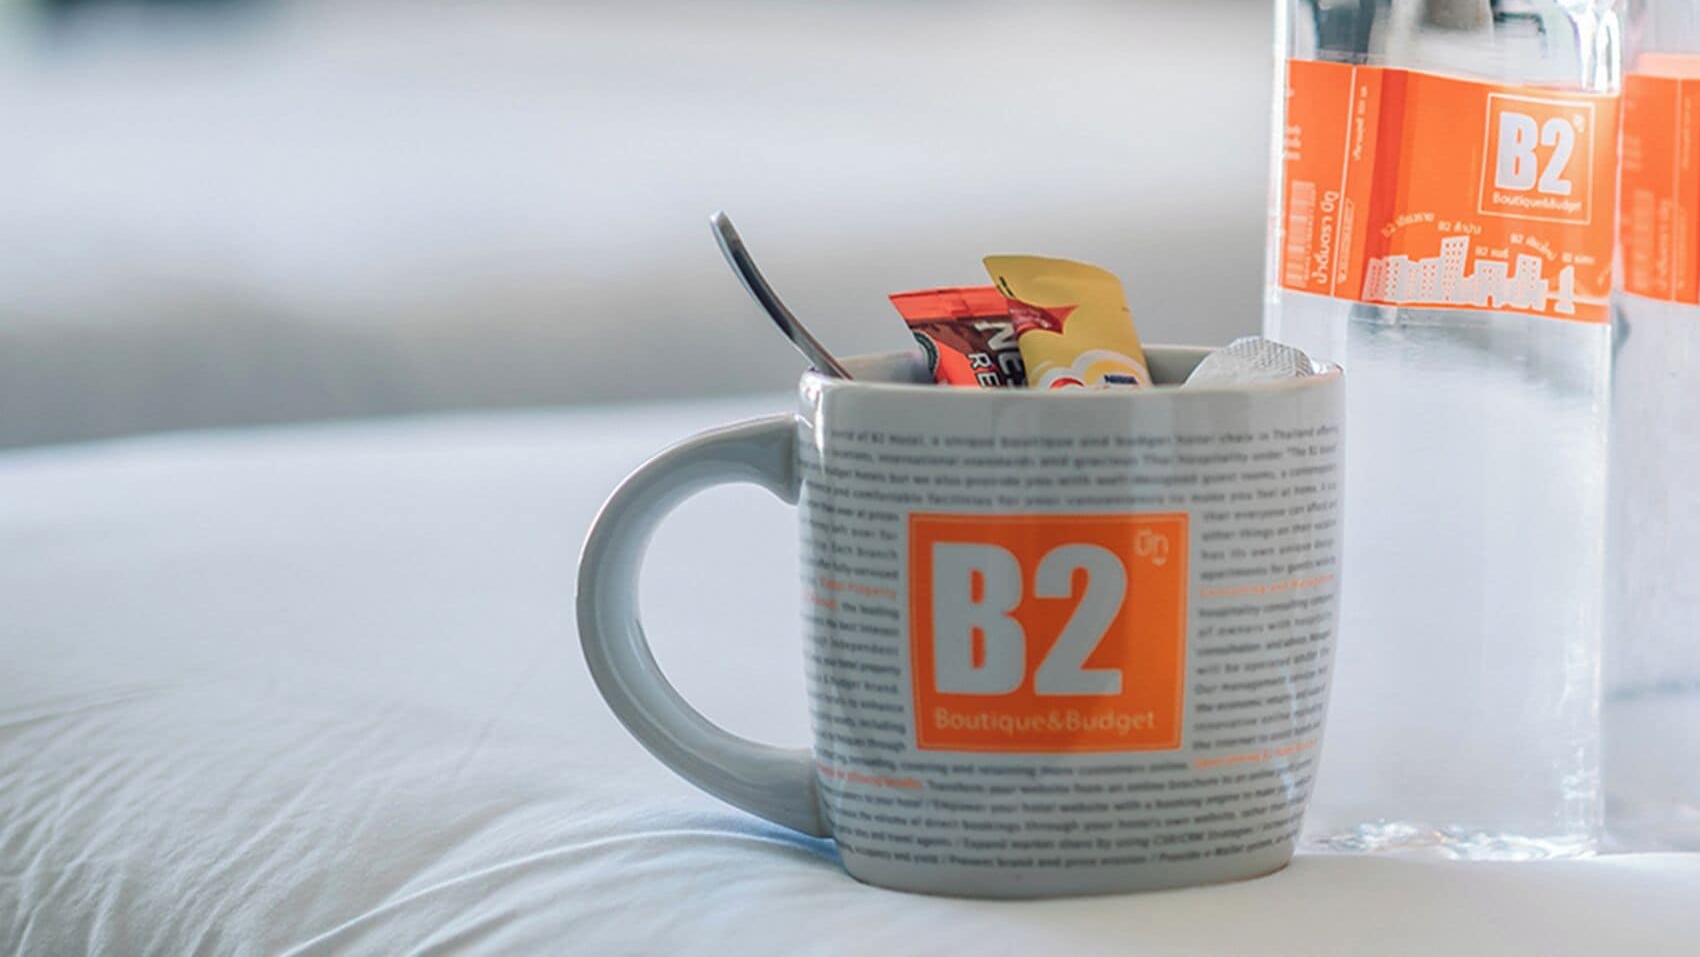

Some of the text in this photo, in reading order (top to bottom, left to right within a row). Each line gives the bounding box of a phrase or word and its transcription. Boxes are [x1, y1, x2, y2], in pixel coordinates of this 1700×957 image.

[1495, 111, 1575, 196] B2
[974, 320, 1024, 386] NE
[932, 541, 1128, 695] B2
[934, 705, 1155, 737] Boutique&Budget
